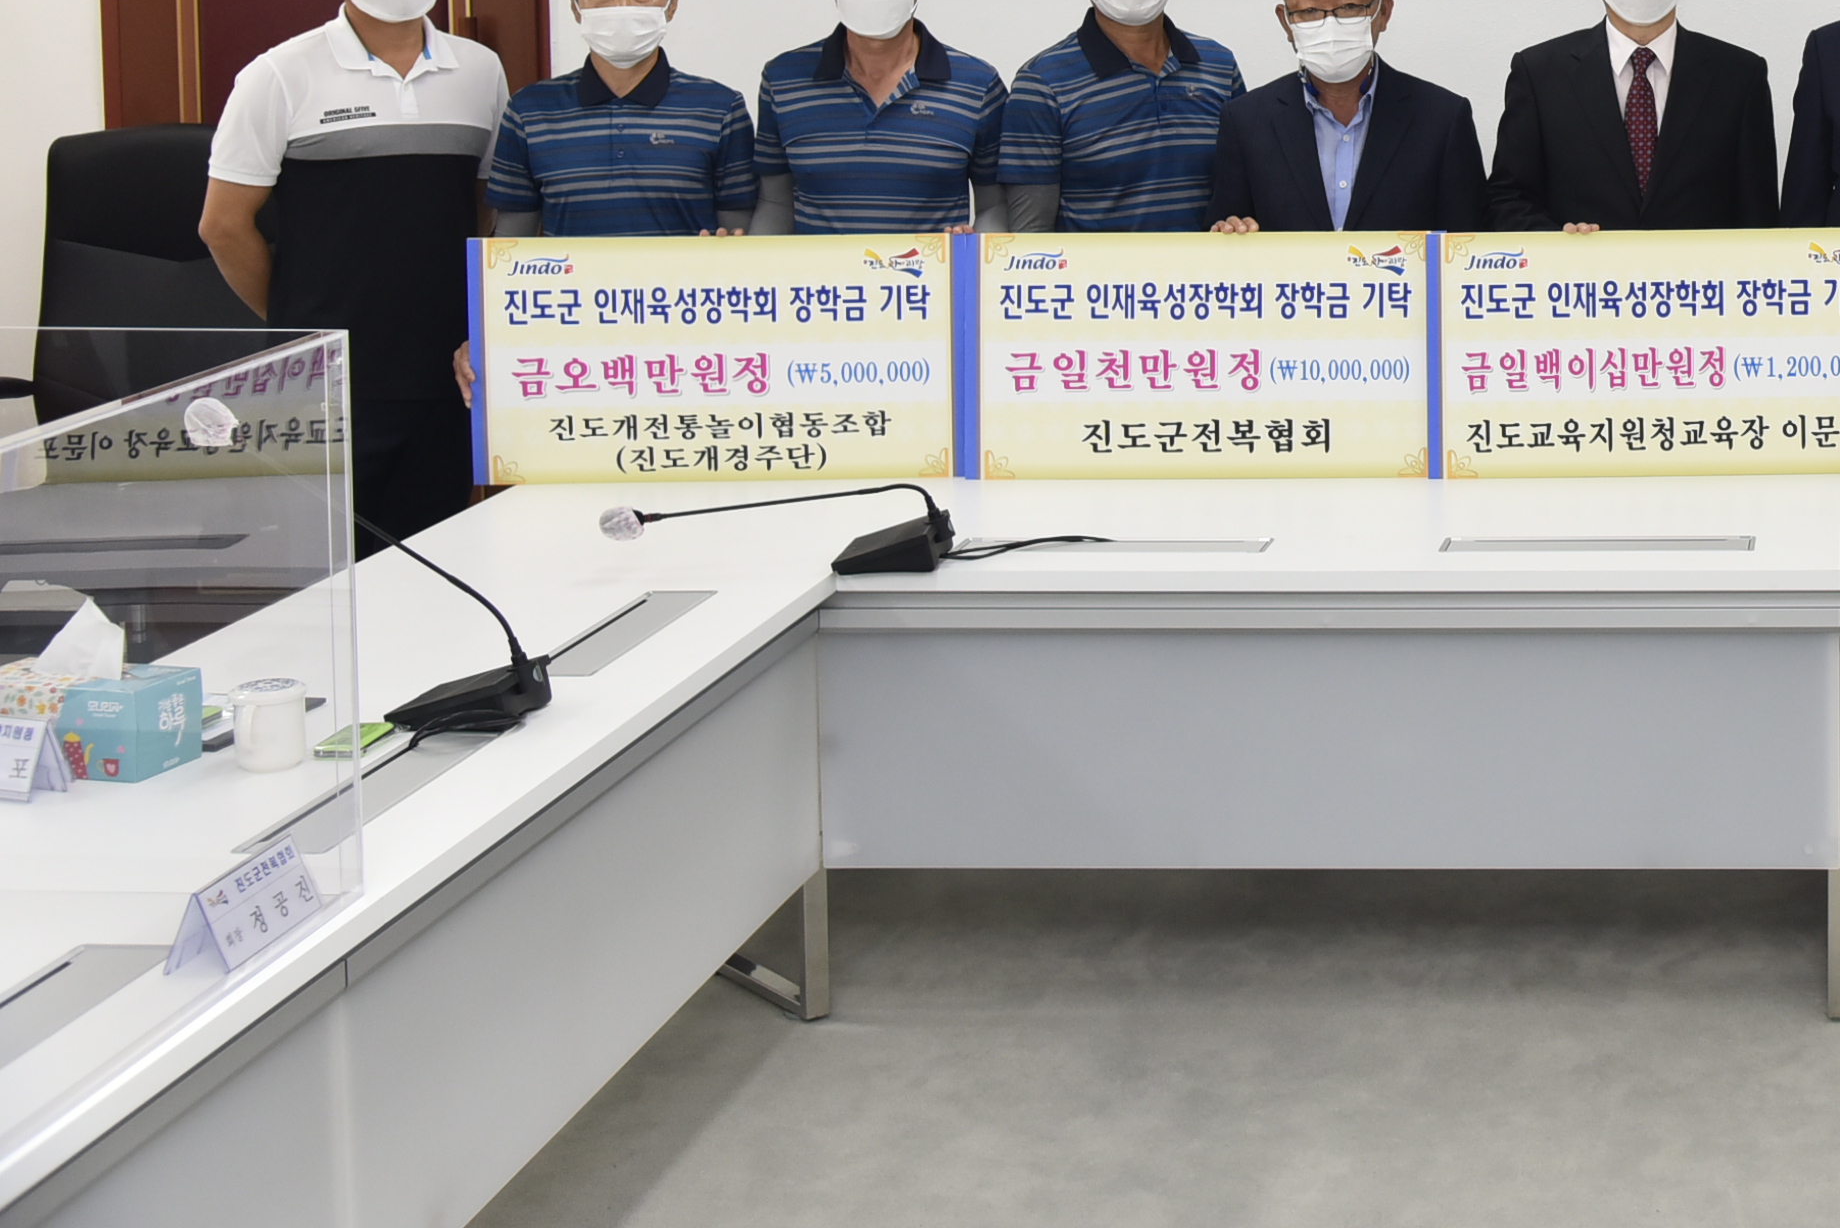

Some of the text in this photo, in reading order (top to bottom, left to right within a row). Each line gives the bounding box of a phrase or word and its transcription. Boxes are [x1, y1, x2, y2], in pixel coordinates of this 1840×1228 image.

[508, 260, 562, 277] Jindo
[1004, 256, 1056, 272] Jindo
[1464, 256, 1517, 271] Jindo
[504, 283, 931, 325] 진도군 인재육성장학회 장학금 기탁
[1000, 280, 1412, 320] 진도군 인재육성장학회 장학금 기탁
[1461, 283, 1536, 319] 진도군
[1547, 280, 1725, 318] 인재육성장학회
[1736, 278, 1812, 317] 장학금
[512, 352, 772, 398] 금오백만원정
[1005, 348, 1263, 392] 금일천만원정
[1461, 345, 1727, 392] 금일백이십만원정
[549, 409, 892, 442] 진도개전통놀이협동조합
[1081, 418, 1332, 454] 진도군전복협회
[1466, 415, 1770, 453] 진도교육지원청교육장
[616, 443, 828, 474] (진도개경주단)
[234, 845, 295, 893] 진도군전복협회
